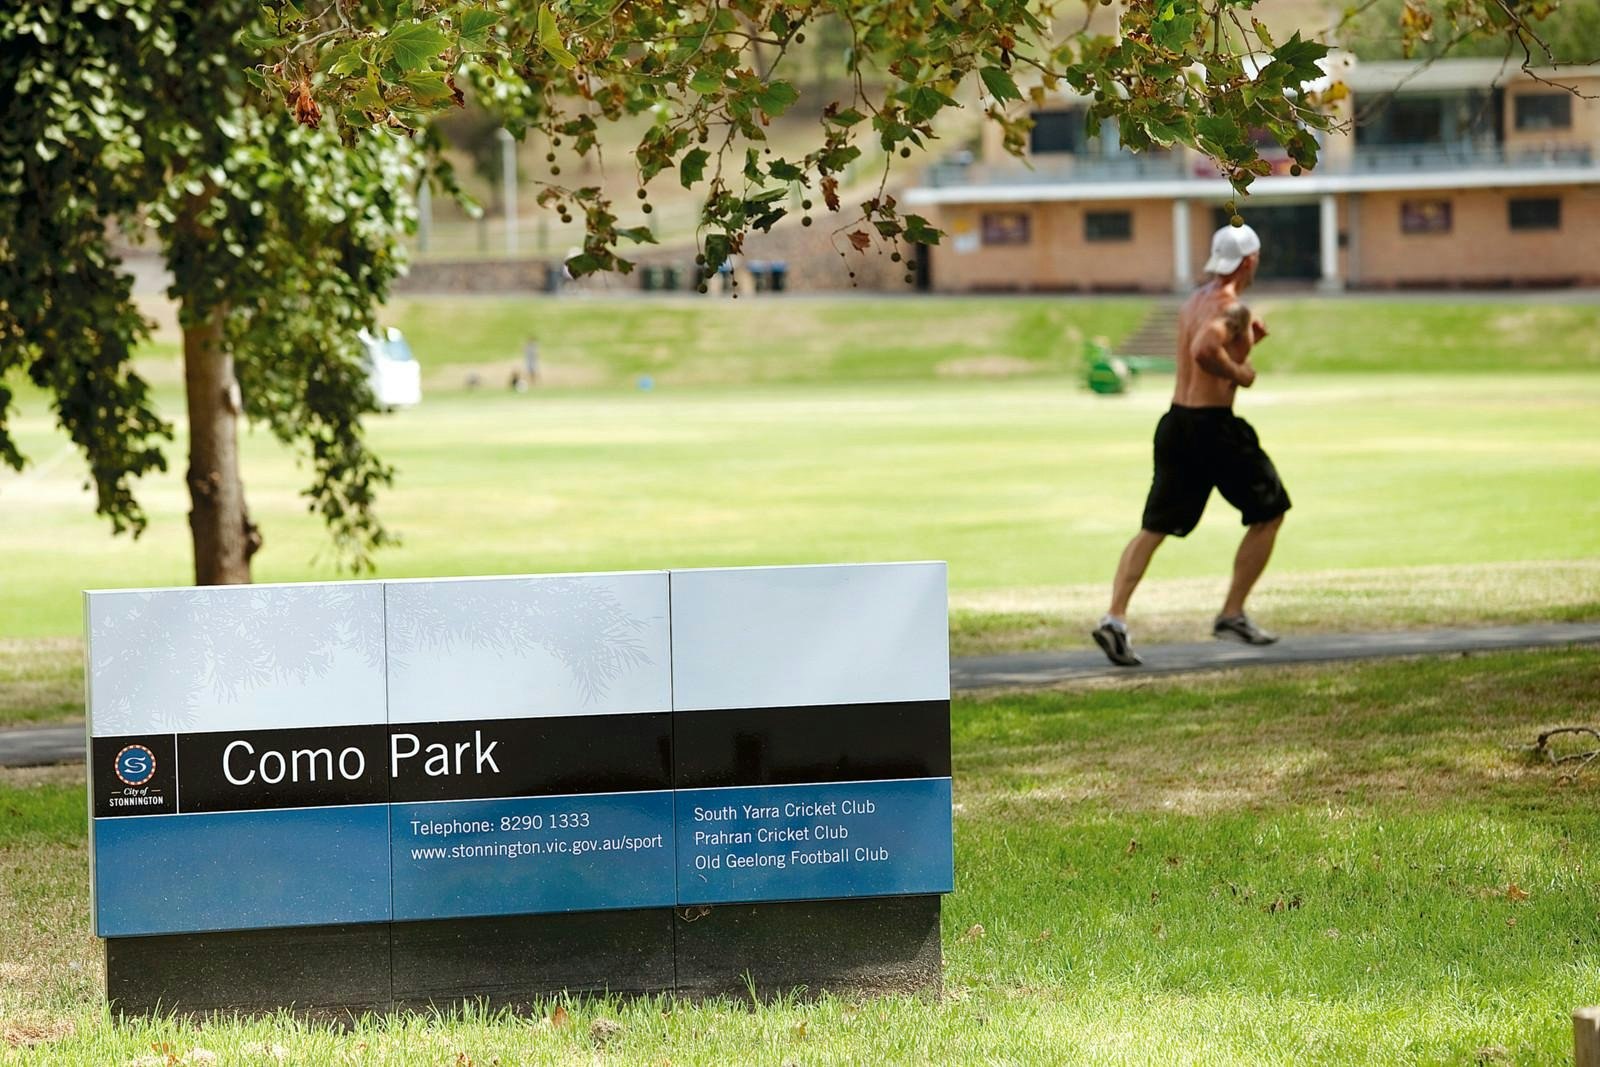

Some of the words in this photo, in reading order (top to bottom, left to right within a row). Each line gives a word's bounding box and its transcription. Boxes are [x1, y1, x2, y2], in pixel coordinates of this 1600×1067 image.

[222, 740, 366, 786] Como
[390, 731, 500, 779] Park
[109, 796, 164, 807] STONNINGTON
[123, 787, 138, 796] City
[140, 786, 149, 796] of
[694, 805, 737, 822] South
[743, 803, 780, 819] Yarra
[784, 800, 837, 817] Cricket
[841, 798, 876, 815] Club
[411, 818, 494, 838] Telephone:
[500, 814, 543, 831] 8290
[549, 812, 590, 829] 1333
[695, 829, 752, 846] Prahran
[757, 826, 810, 843] Cricket
[814, 824, 849, 840] Club
[410, 834, 663, 860] www.stonnington.vic.gov.au/sport
[695, 853, 720, 870] Old
[726, 850, 786, 871] Geelong
[791, 848, 849, 865] Football
[854, 846, 889, 862] Club
